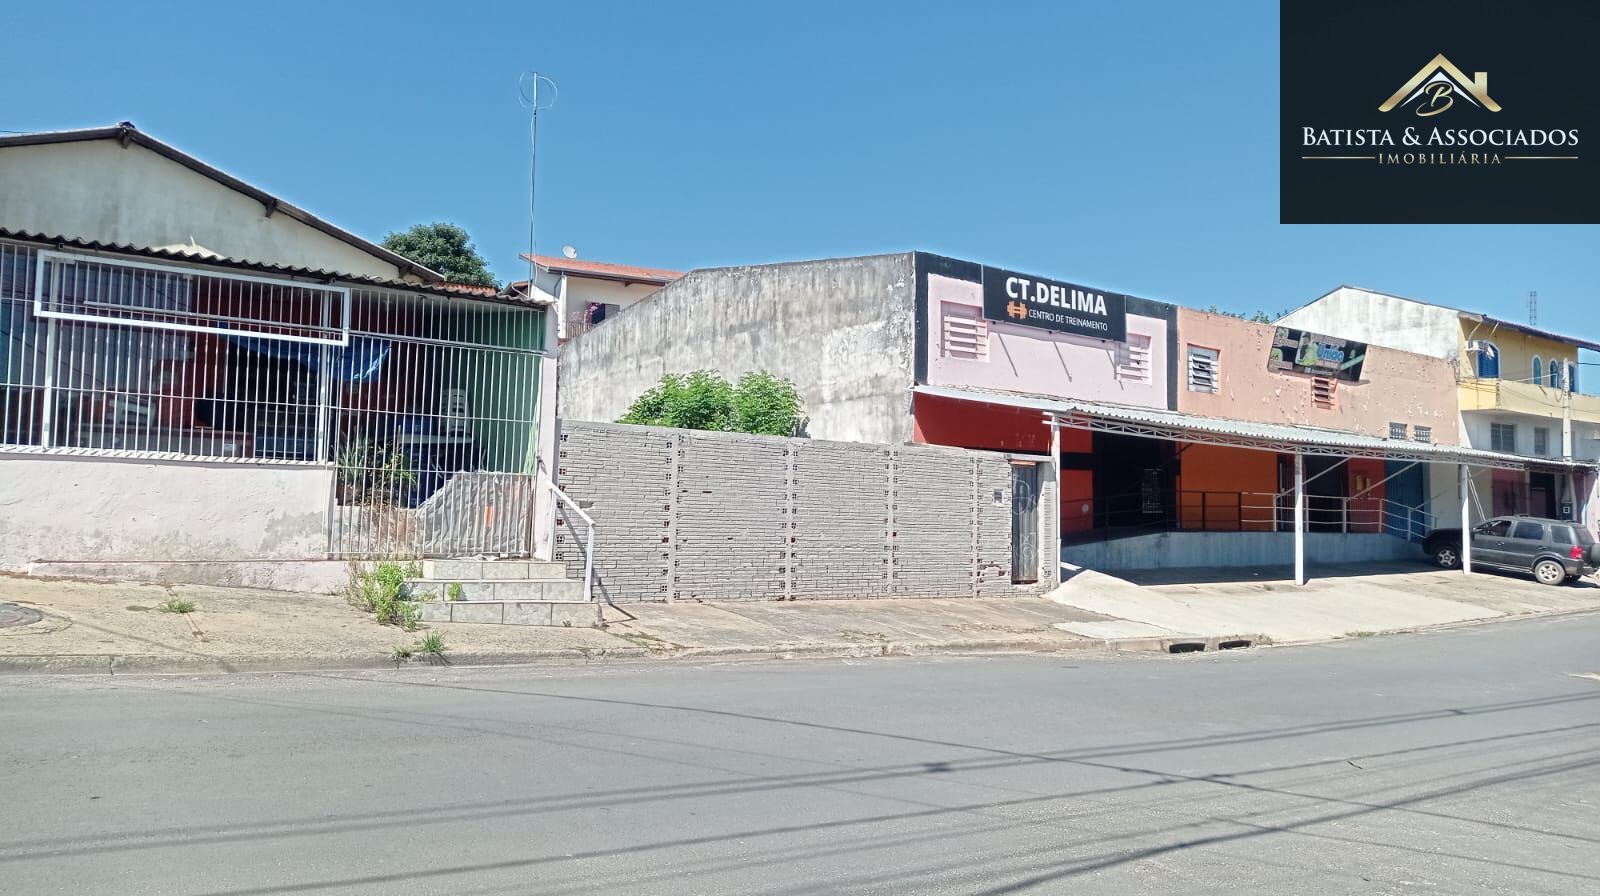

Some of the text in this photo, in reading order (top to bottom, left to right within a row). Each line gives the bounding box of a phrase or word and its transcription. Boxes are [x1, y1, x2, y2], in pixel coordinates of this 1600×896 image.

[1006, 276, 1108, 316] CT.DELIMA
[1028, 308, 1108, 332] CENTRO DE TREINAMENTO
